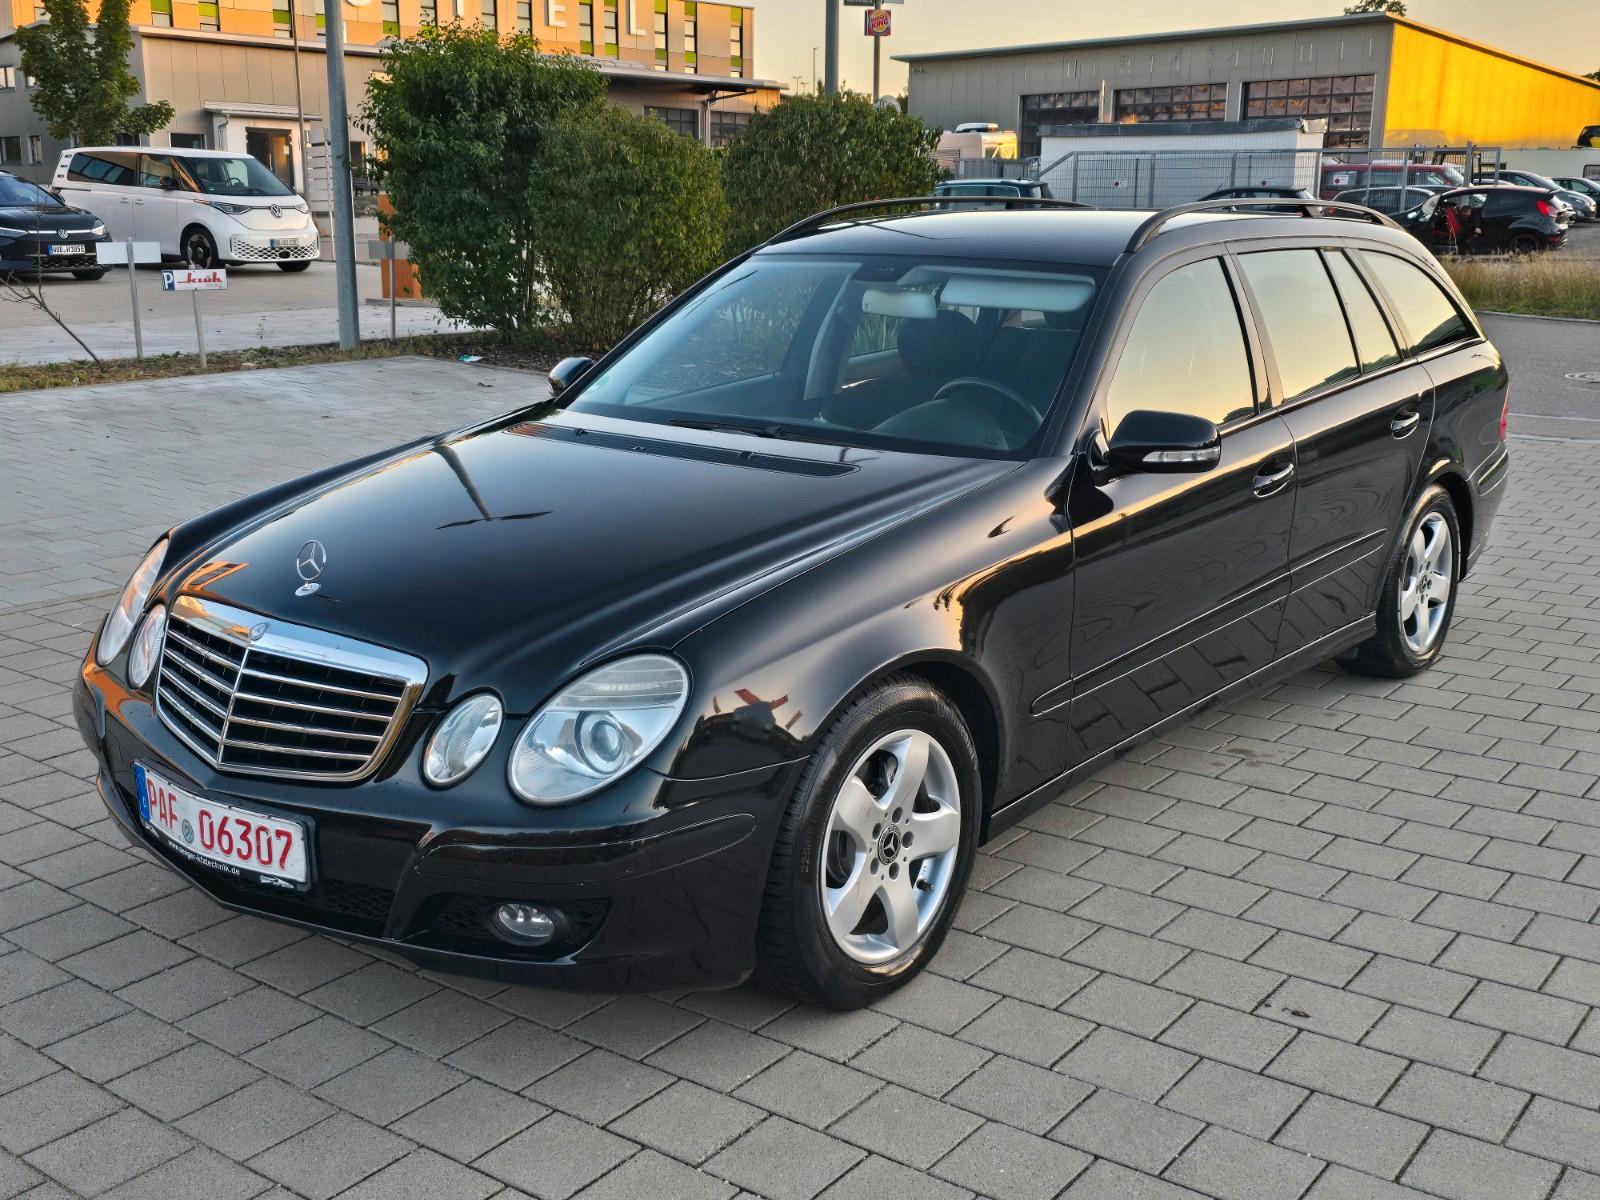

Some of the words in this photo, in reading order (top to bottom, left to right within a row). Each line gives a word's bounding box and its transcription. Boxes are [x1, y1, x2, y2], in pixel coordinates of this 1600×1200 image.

[163, 272, 174, 289] P
[147, 778, 178, 829] PAF
[199, 809, 293, 870] 06307
